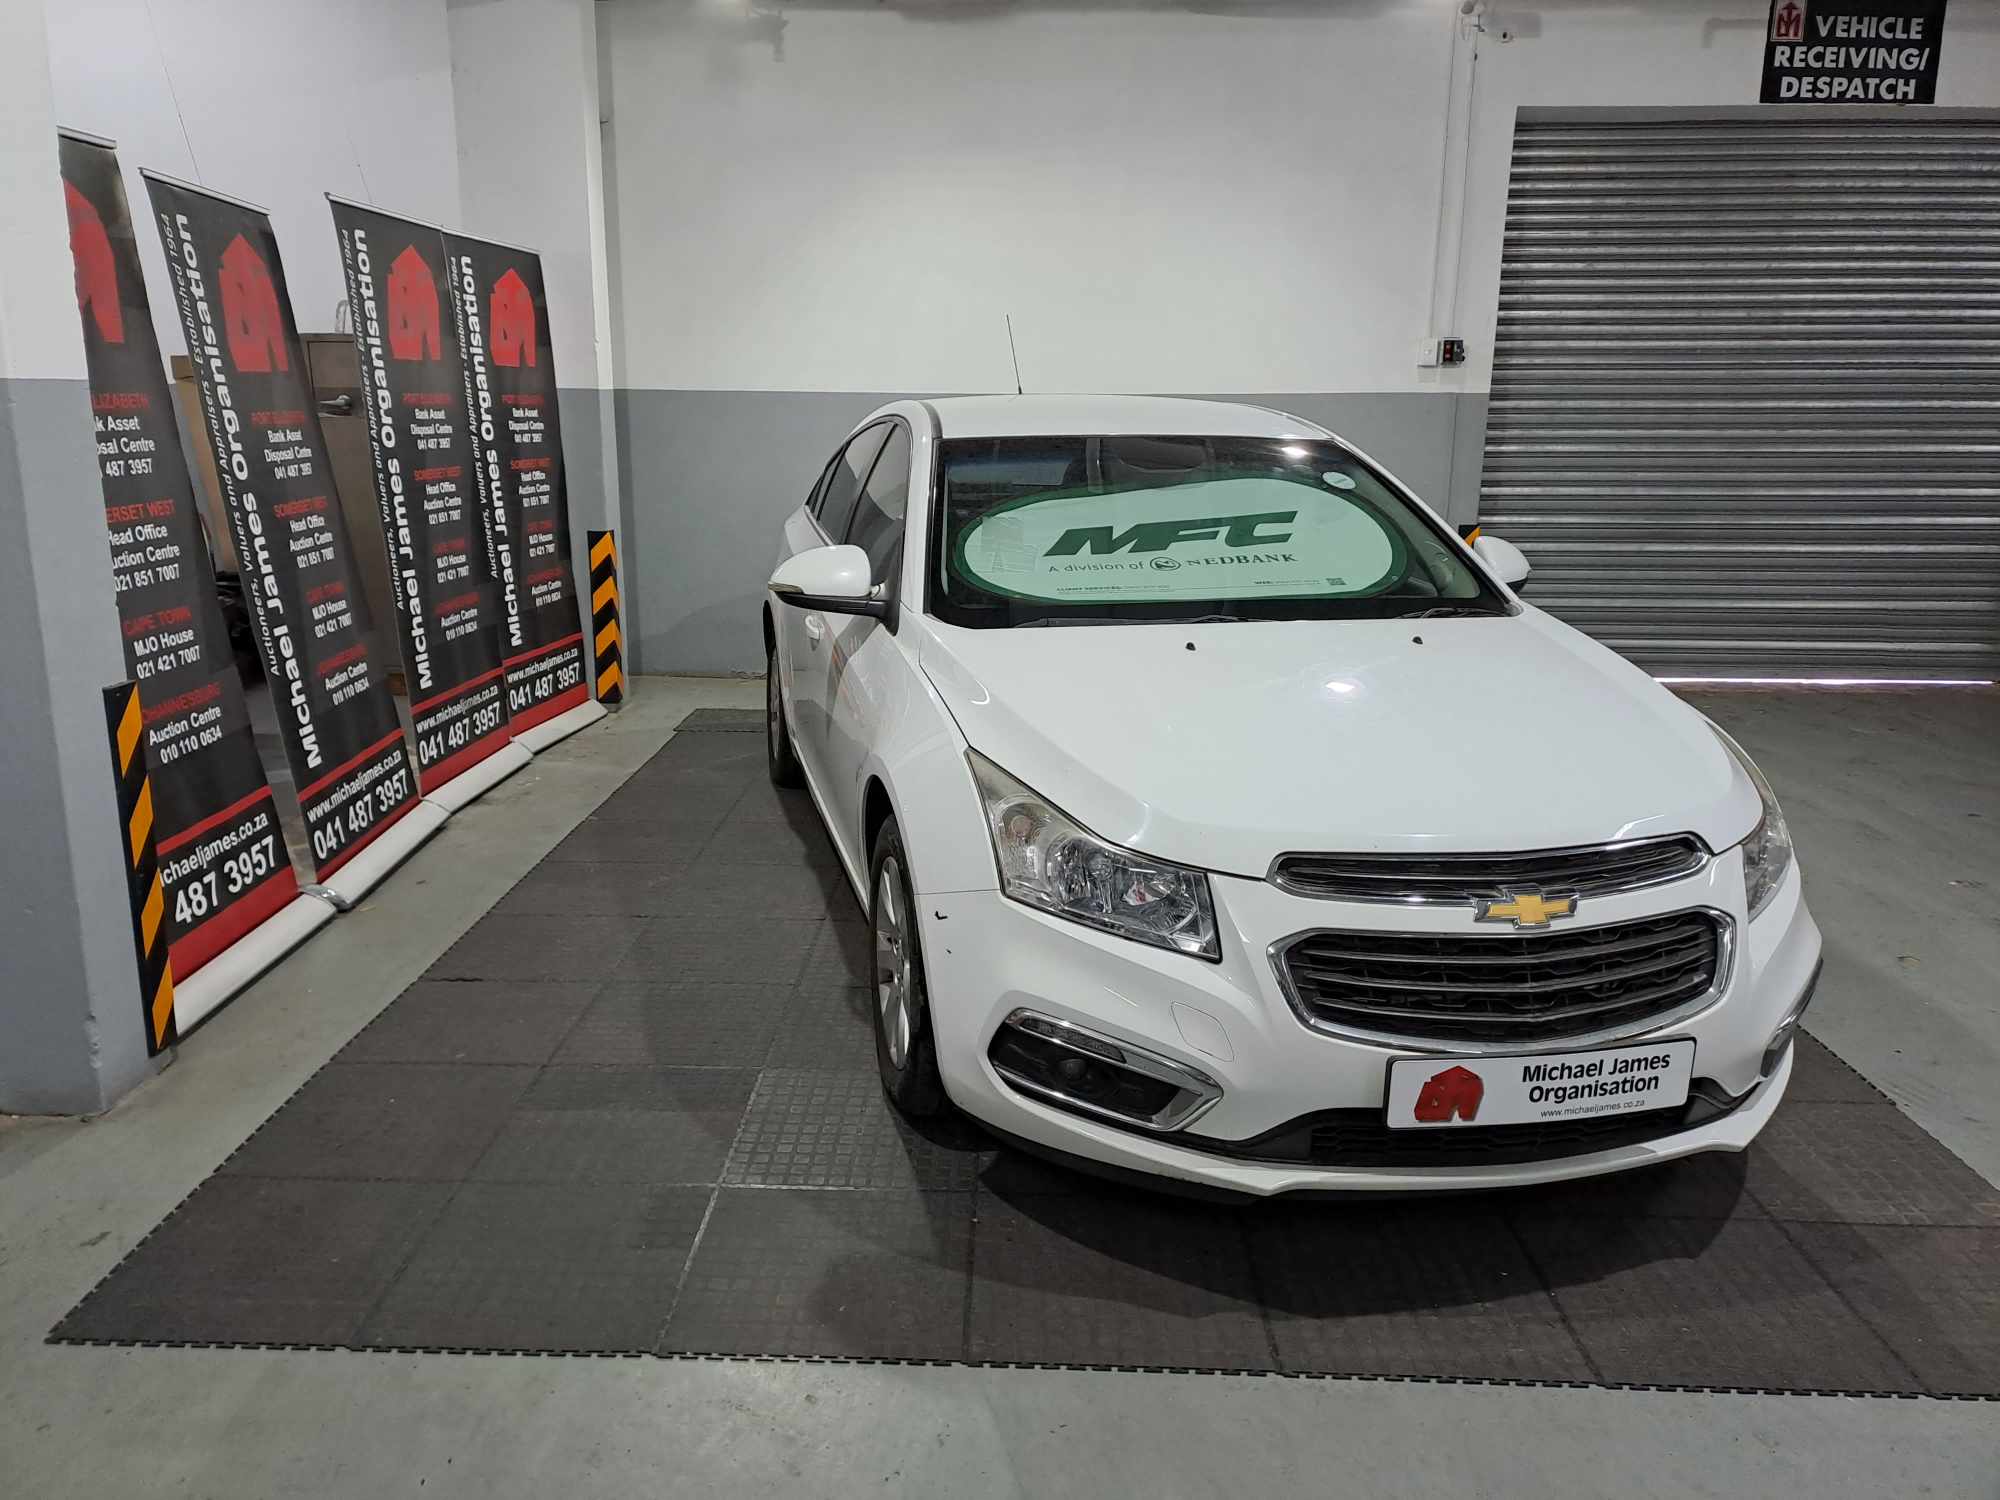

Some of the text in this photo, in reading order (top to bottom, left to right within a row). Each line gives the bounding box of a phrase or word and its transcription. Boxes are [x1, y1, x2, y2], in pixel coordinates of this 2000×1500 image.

[1815, 15, 1925, 40] VEHICLE
[1773, 45, 1930, 71] RECEIVING/
[1779, 76, 1917, 101] DESPATCH
[171, 262, 204, 364] Established
[361, 364, 378, 440] Appraisers
[107, 415, 140, 431] Asset
[201, 380, 229, 470] Appraisers
[120, 437, 156, 453] Centre
[354, 229, 433, 690] Michael James Organisation
[371, 441, 382, 469] and
[460, 255, 523, 647] Michael James Organisation
[470, 435, 481, 459] and
[105, 458, 152, 477] 487 3957
[175, 213, 323, 769] Michael James Organisation
[222, 473, 238, 506] and
[377, 472, 391, 523] Valuers
[135, 524, 168, 541] Office
[233, 511, 254, 572] Valuers
[1042, 510, 1299, 557] MFC
[146, 544, 181, 562] Centre
[1064, 562, 1125, 572] division
[1128, 561, 1145, 570] of
[1186, 553, 1298, 567] NEDBANK
[134, 568, 155, 588] 851
[156, 563, 180, 582] 7007
[134, 629, 194, 657] MJO House
[251, 578, 281, 676] Auctioneers,
[136, 645, 201, 680] 021 421 7007
[509, 661, 580, 711] 041 487 3957
[149, 706, 222, 746] Auction Centre
[160, 725, 223, 764] 010 110 0634
[419, 701, 500, 766] 041 487 3957
[306, 749, 402, 823] www.michaeljames.co.za
[313, 768, 408, 859] 041 487 3957
[175, 834, 276, 924] 487 3957
[1522, 1053, 1671, 1083] Michael James
[1528, 1075, 1660, 1105] Organisation
